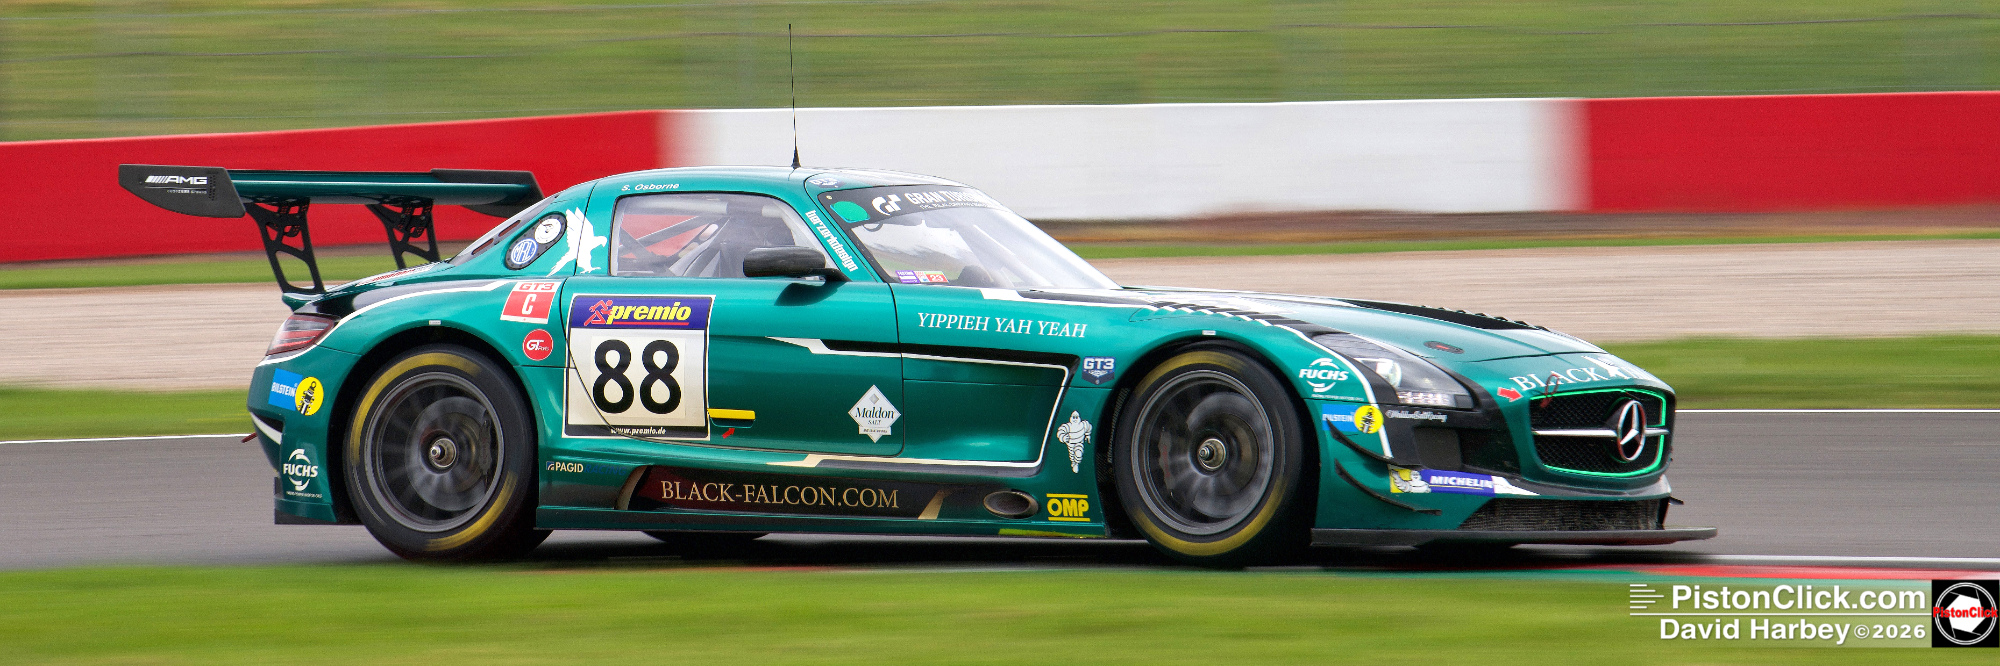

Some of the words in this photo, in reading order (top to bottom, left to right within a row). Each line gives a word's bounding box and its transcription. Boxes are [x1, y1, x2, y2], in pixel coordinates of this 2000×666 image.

[634, 183, 680, 191] Osborne
[904, 191, 947, 205] GRAN
[519, 282, 555, 291] GT3
[522, 293, 537, 315] C
[606, 301, 692, 325] premio
[917, 312, 990, 332] YIPPIEH
[994, 317, 1034, 335] YAH
[1037, 320, 1088, 338] YEAH
[1083, 357, 1115, 370] GT3
[592, 339, 682, 415] 88
[1299, 368, 1350, 381] FUCHS
[1509, 367, 1611, 391] BLACK
[271, 382, 296, 397] BILSTEIN
[855, 407, 895, 419] Maldon
[282, 463, 319, 478] FUCHS
[555, 461, 584, 473] PAGID
[584, 464, 627, 475] RACING
[1430, 475, 1495, 489] MICHELIN
[661, 480, 900, 508] BLACK-FALCON.COM
[1047, 499, 1090, 518] OMP
